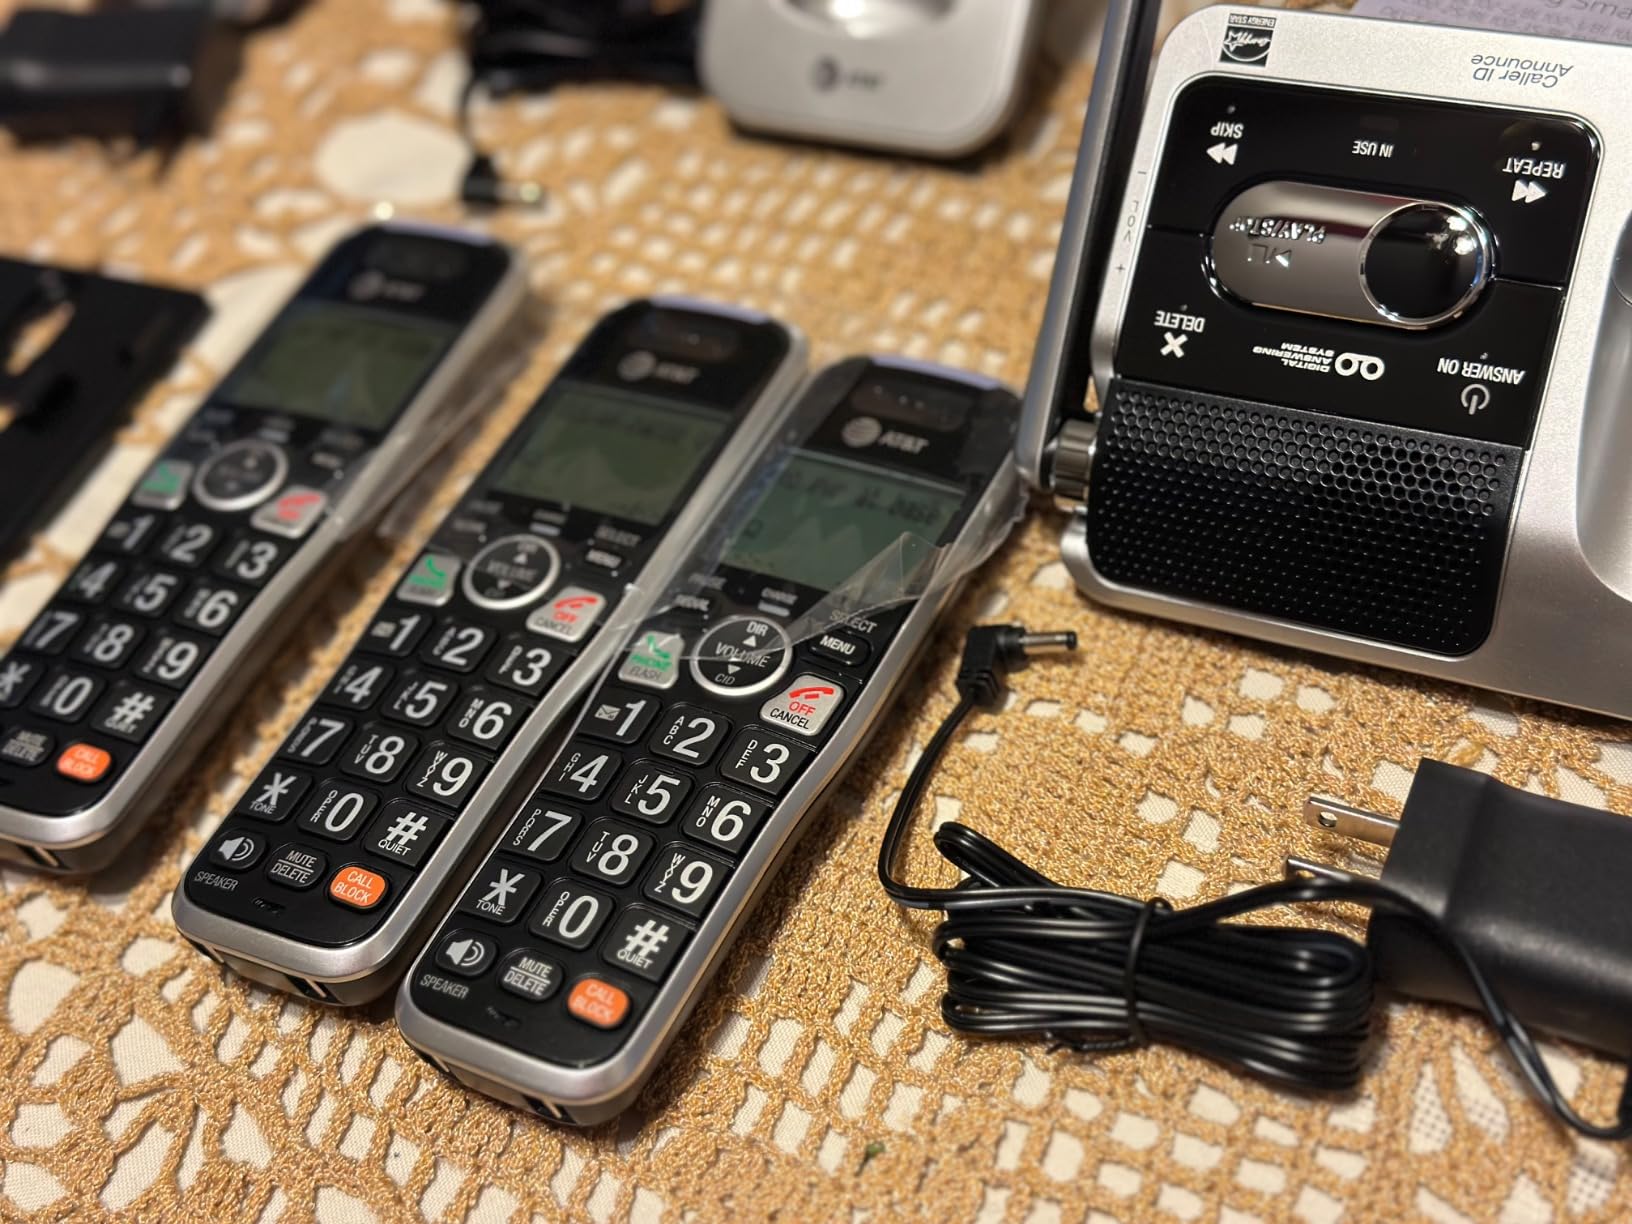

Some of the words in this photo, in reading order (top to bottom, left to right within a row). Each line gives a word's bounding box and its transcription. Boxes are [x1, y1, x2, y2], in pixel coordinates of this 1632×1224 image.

[1230, 15, 1248, 24] STAR
[1248, 16, 1275, 27] ENERGY
[1471, 54, 1574, 76] Announce
[1473, 67, 1494, 82] ID
[1499, 70, 1559, 88] Caller
[1210, 121, 1244, 138] SKIP
[1352, 140, 1377, 156] USE
[1379, 142, 1394, 158] IN
[1502, 157, 1566, 178] REPEAT
[1124, 200, 1139, 242] VOL
[1154, 310, 1205, 332] DELETE
[1252, 346, 1333, 365] ANSWERING
[1281, 342, 1335, 357] SYSTEM
[1281, 358, 1330, 373] DIGITAL
[1437, 357, 1459, 375] ON
[1461, 361, 1525, 385] ANSWER
[122, 514, 155, 549] 1
[170, 524, 213, 563] 2
[237, 541, 278, 579] 3
[79, 561, 117, 599] 4
[133, 573, 177, 611] 5
[197, 589, 238, 628] 6
[830, 608, 877, 633] SELECT
[35, 610, 79, 649] 7
[93, 623, 134, 661] 8
[389, 614, 421, 650] 1
[746, 621, 769, 637] DIR
[441, 627, 484, 666] 2
[715, 641, 771, 668] VOLUME
[820, 635, 856, 655] MENU
[157, 641, 199, 680] 9
[512, 648, 552, 686] 3
[344, 666, 383, 703] 4
[714, 673, 735, 686] CID
[53, 676, 94, 715] 0
[404, 680, 448, 720] 5
[788, 701, 816, 716] OFF
[458, 698, 484, 728] MNO
[472, 701, 512, 740] 6
[616, 699, 647, 736] 1
[770, 708, 809, 730] CANCEL
[300, 718, 345, 757] 7
[663, 715, 685, 745] ABC
[672, 717, 715, 759] 2
[354, 734, 379, 764] TUV
[365, 735, 405, 775] 8
[735, 740, 758, 769] DEF
[749, 743, 790, 784] 3
[432, 756, 473, 797] 9
[558, 753, 581, 782] GHI
[570, 754, 609, 793] 4
[624, 774, 649, 804] JKL
[637, 774, 681, 816] 5
[249, 800, 278, 815] TONE
[309, 789, 338, 823] OPER
[324, 792, 364, 833] 0
[695, 795, 721, 828] MNO
[710, 800, 752, 842] 6
[512, 808, 542, 846] PQRS
[527, 810, 573, 852] 7
[285, 850, 317, 868] MUTE
[377, 839, 411, 856] QUIET
[586, 831, 611, 863] TUV
[597, 834, 639, 876] 8
[194, 870, 238, 892] SPEAKER
[270, 862, 311, 884] DELETE
[347, 870, 375, 889] CALL
[654, 852, 686, 893] WXYZ
[671, 860, 713, 905] 9
[333, 882, 372, 904] BLOCK
[476, 899, 506, 916] TONE
[542, 891, 570, 927] OPER
[558, 895, 599, 939] 0
[518, 956, 553, 978] MUTE
[616, 948, 654, 970] QUIET
[420, 974, 469, 1000] SPEAKER
[503, 970, 548, 996] DELETE
[585, 983, 616, 1005] CALL
[572, 993, 614, 1021] BLOCK
